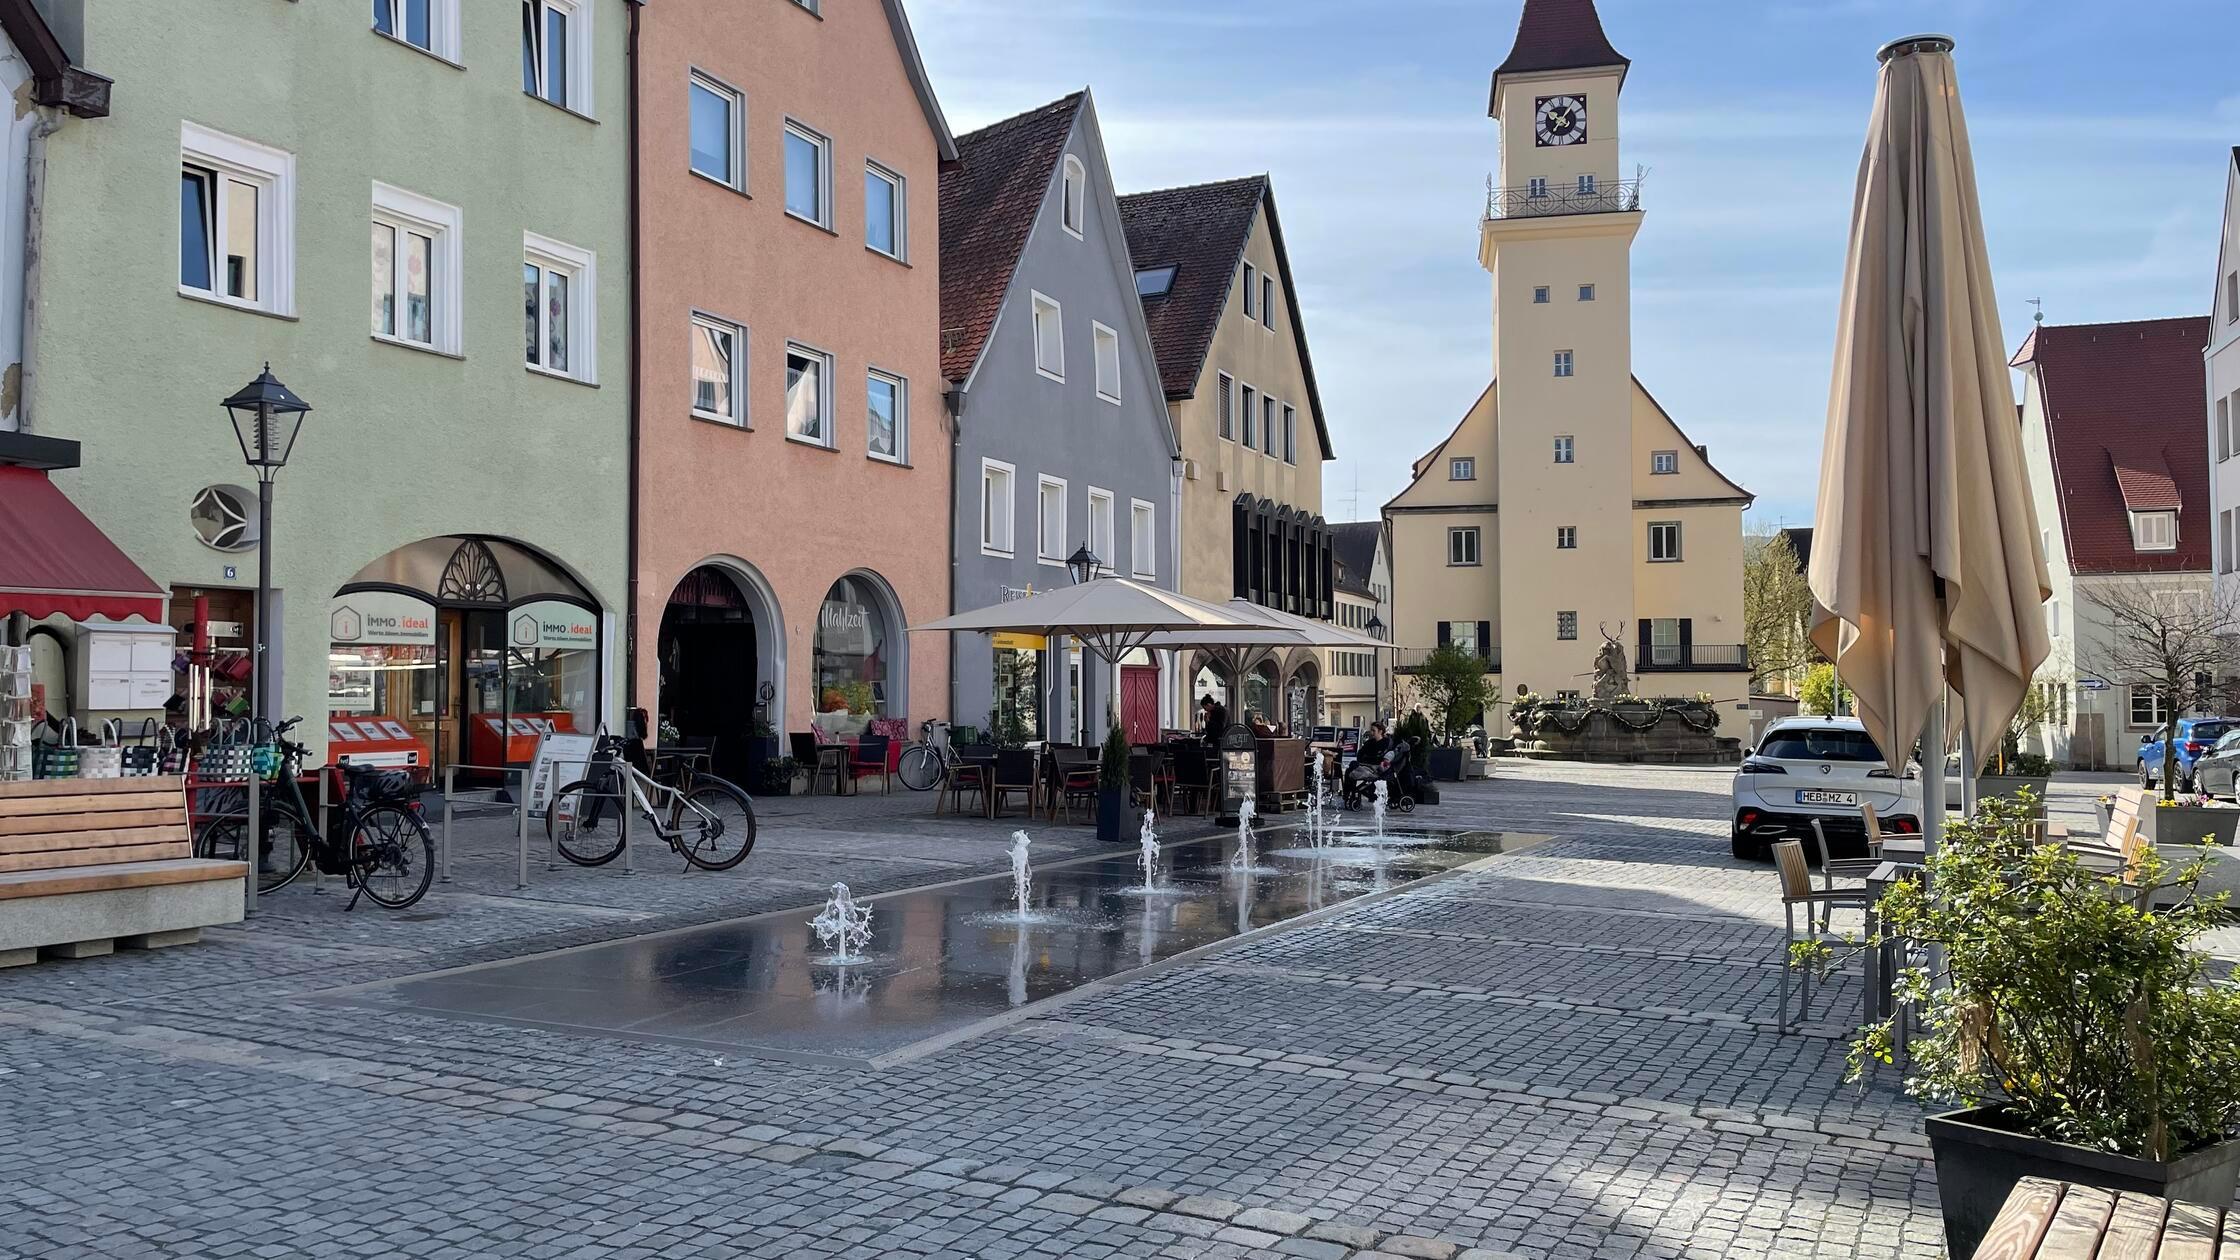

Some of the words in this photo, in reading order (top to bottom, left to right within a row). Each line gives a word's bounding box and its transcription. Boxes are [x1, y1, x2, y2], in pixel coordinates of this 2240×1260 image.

[226, 567, 234, 577] 6
[821, 603, 870, 631] Mahlzeit
[1803, 792, 1822, 802] HEB
[1828, 793, 1842, 803] MZ
[1846, 794, 1853, 804] 4
